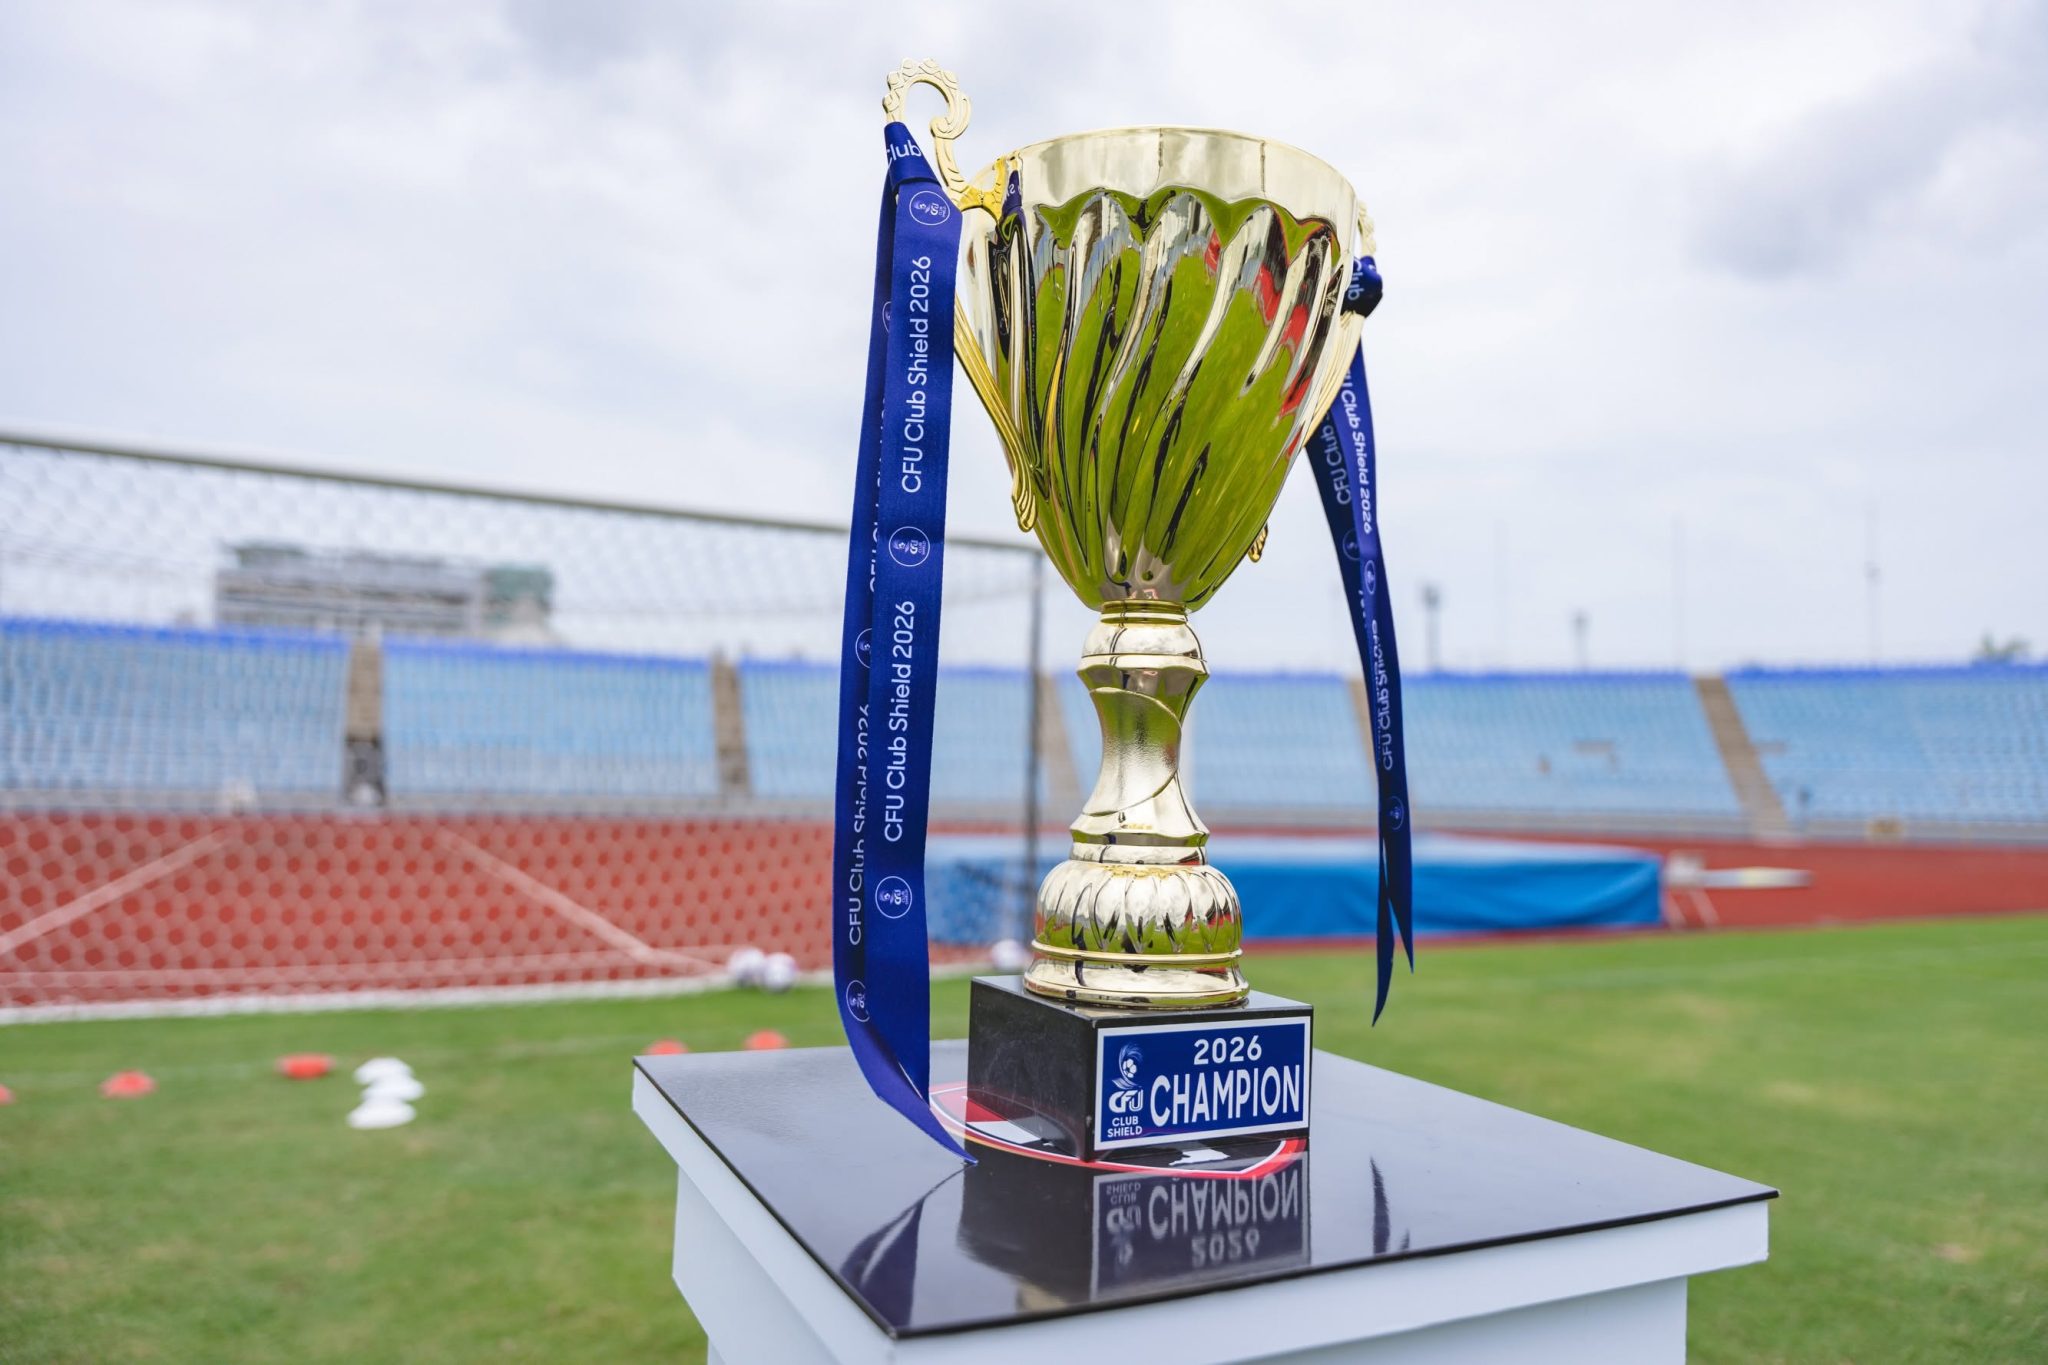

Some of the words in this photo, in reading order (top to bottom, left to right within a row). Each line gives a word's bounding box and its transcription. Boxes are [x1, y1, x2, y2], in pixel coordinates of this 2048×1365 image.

[887, 139, 922, 165] lub
[910, 255, 931, 313] 2026
[907, 318, 929, 386] Shield
[904, 390, 926, 442] Club
[1341, 389, 1361, 428] Club
[1320, 424, 1342, 466] Club
[1352, 431, 1370, 485] Shield
[901, 446, 923, 493] CFU
[1331, 468, 1351, 505] CFU
[1360, 487, 1373, 535] 2026
[892, 601, 915, 659] 2026
[889, 664, 911, 732] Shield
[1378, 688, 1392, 730] Club
[886, 737, 907, 790] Club
[1382, 733, 1394, 771] CFU
[884, 795, 904, 842] CFU
[848, 898, 862, 945] CFU
[1193, 1035, 1262, 1065] 2026
[1108, 1088, 1144, 1113] CFU
[1150, 1064, 1300, 1127] CHAMPION
[1107, 1125, 1143, 1138] SHIELD
[1112, 1116, 1139, 1127] CLUB
